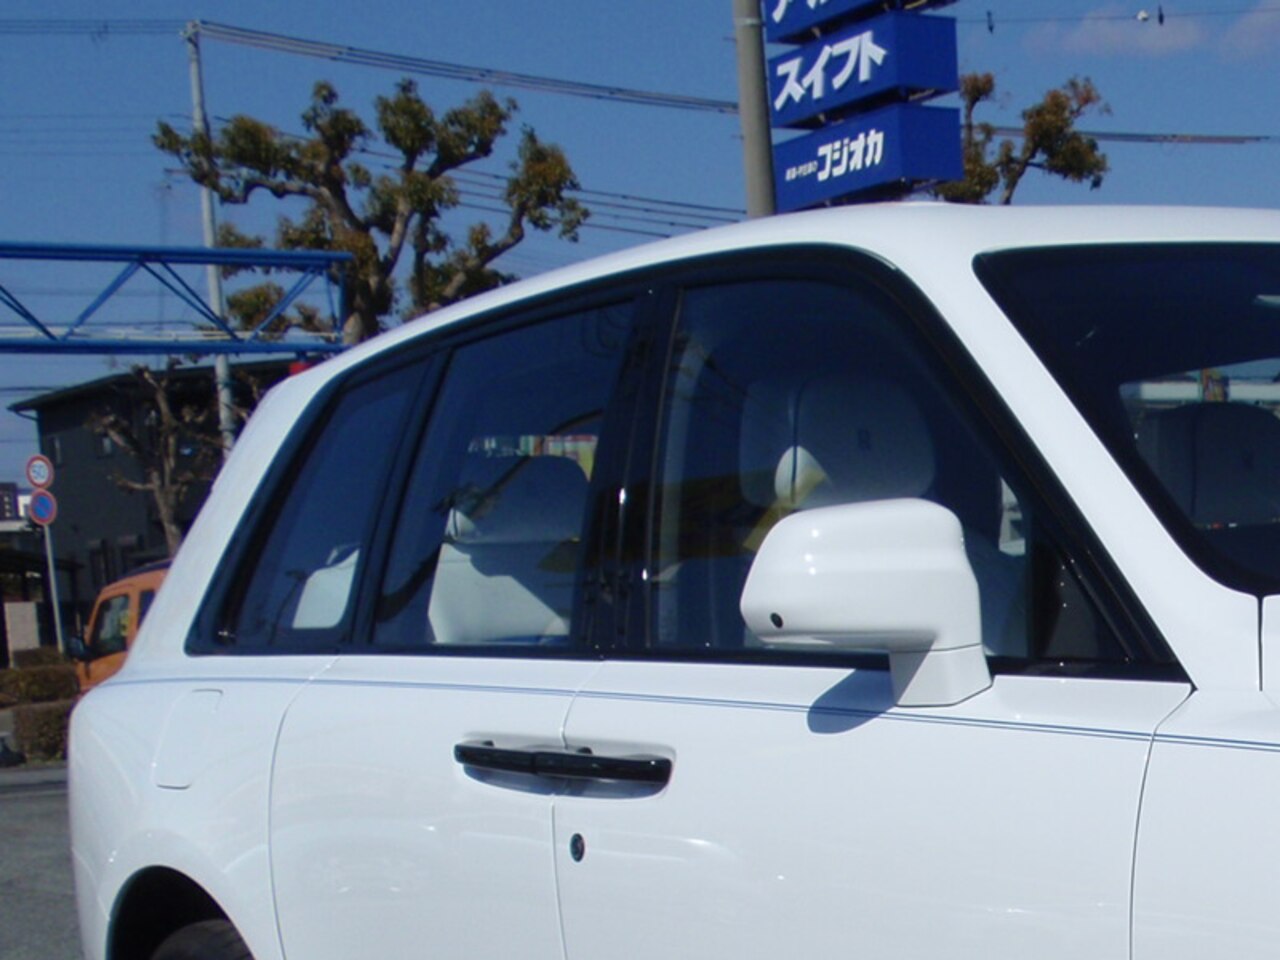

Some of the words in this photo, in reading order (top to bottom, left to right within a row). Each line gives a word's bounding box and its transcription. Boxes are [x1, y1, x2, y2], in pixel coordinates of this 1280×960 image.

[775, 30, 886, 111] スイフト
[817, 128, 884, 181] フジオカ
